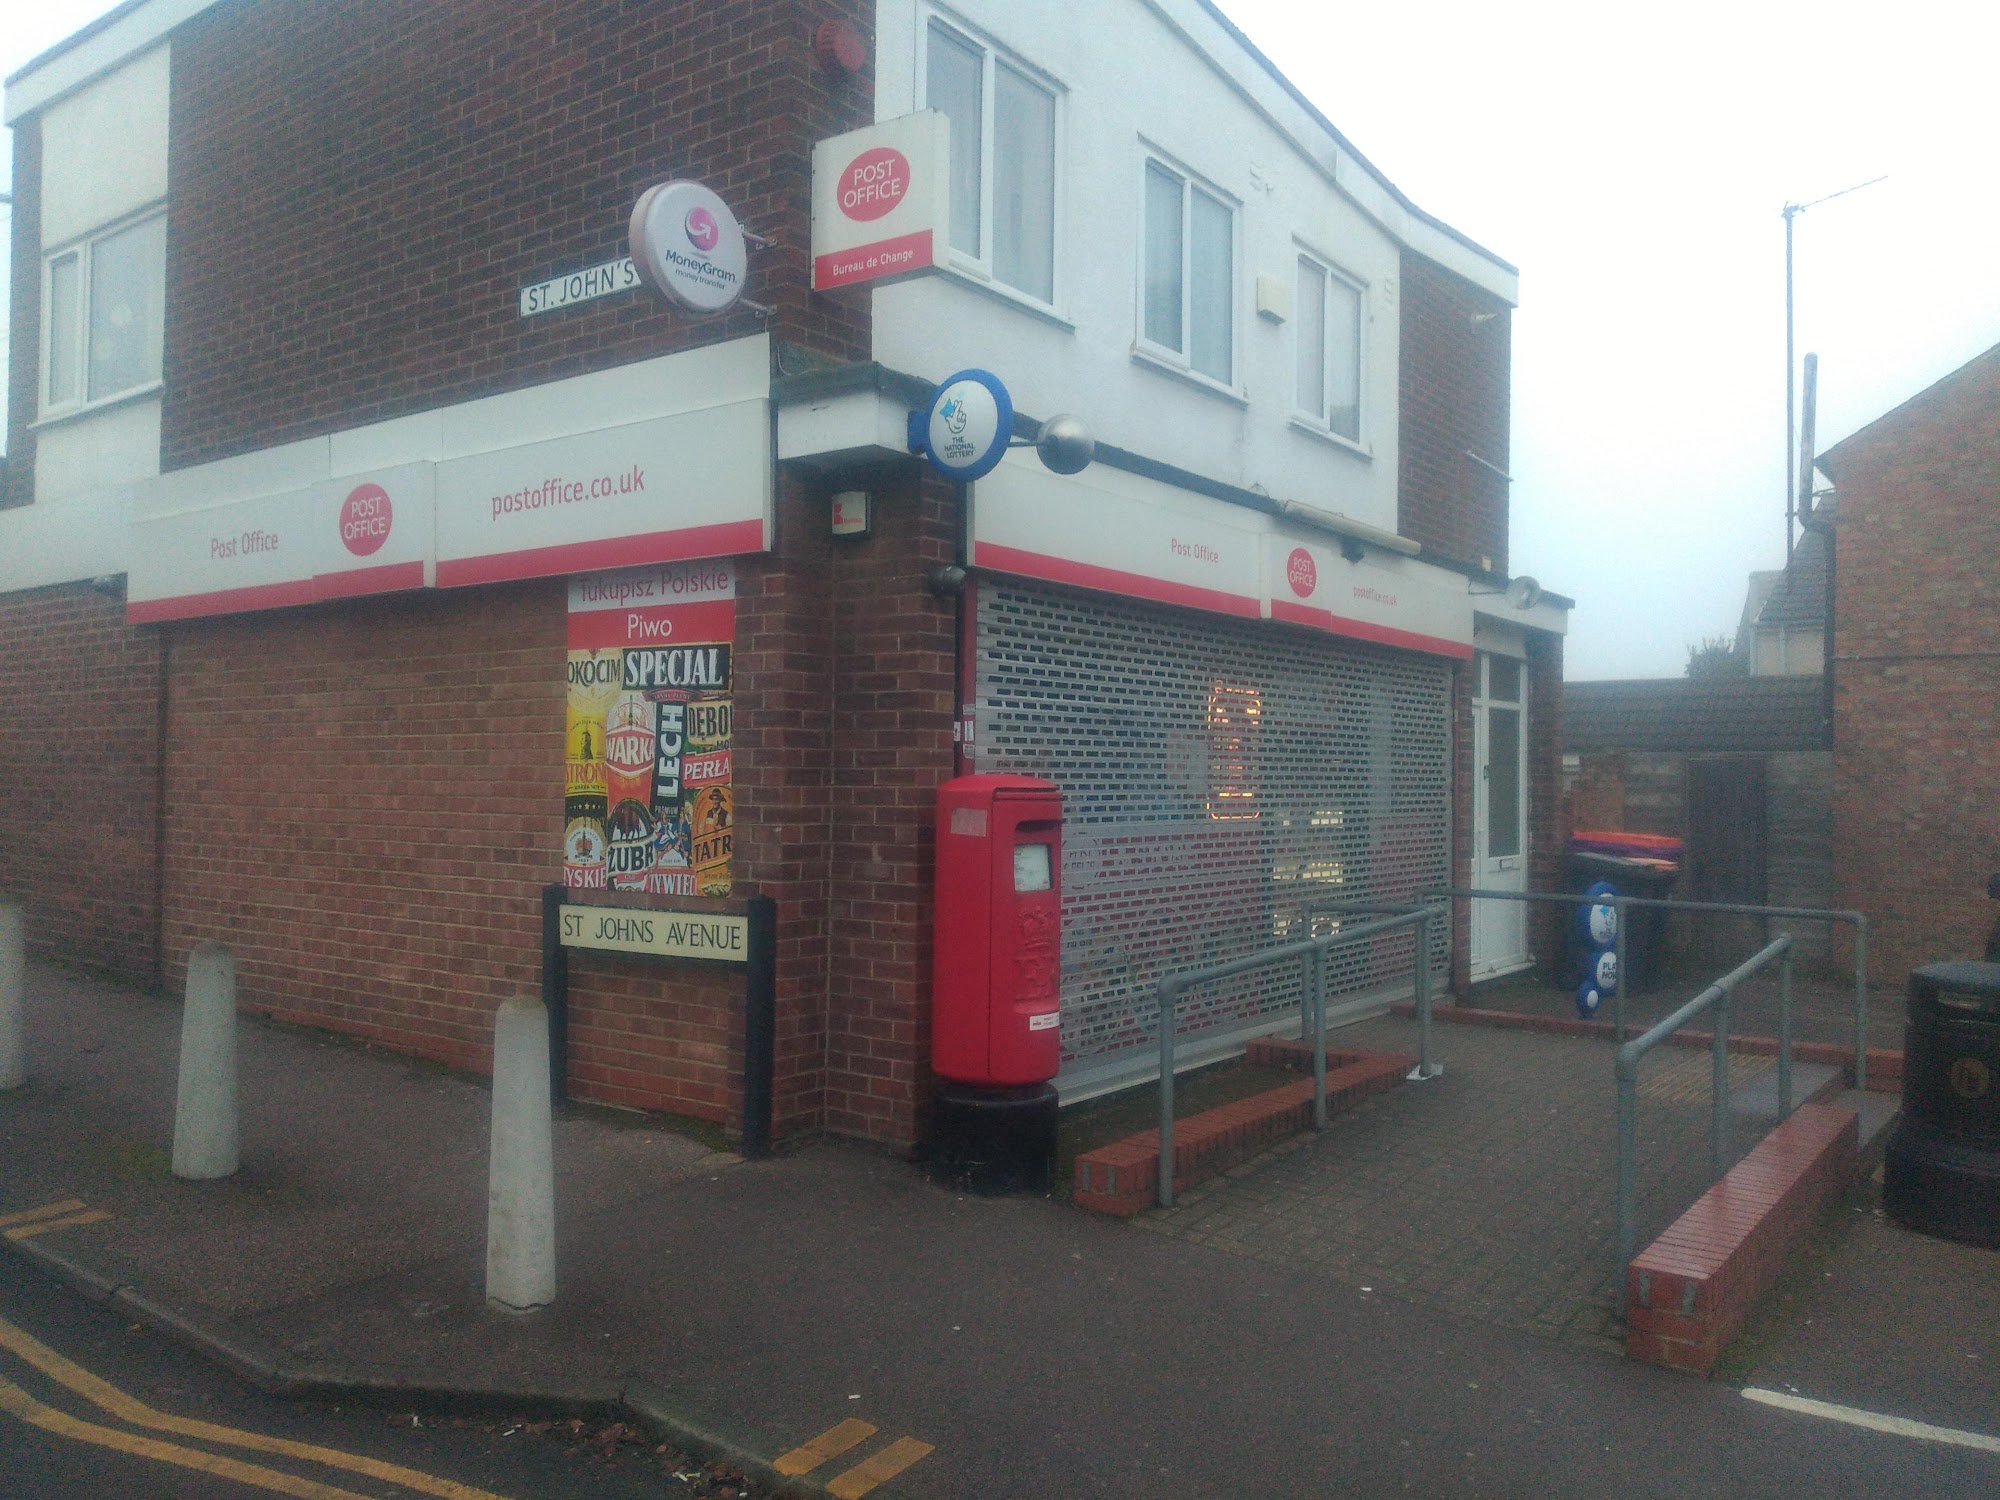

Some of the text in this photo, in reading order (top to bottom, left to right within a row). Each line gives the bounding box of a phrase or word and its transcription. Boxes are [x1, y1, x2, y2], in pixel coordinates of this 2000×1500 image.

[854, 159, 895, 186] POST
[844, 178, 900, 208] OFFICE
[665, 249, 736, 284] MoneyGram
[833, 249, 914, 276] Bureau de Change
[529, 259, 634, 312] ST. JOHN'S
[675, 268, 726, 290] money transfer
[944, 443, 975, 452] NATIONAL
[952, 436, 964, 444] THE
[946, 450, 975, 459] LOTTERY
[492, 464, 645, 521] postoffice.co.uk
[351, 496, 381, 518] POST
[344, 517, 386, 540] OFFICE
[211, 530, 279, 559] Post Office
[1171, 538, 1219, 563] Post Office
[1293, 557, 1311, 573] POST
[661, 567, 729, 595] Polskie
[1289, 570, 1313, 587] OFFICE
[1353, 586, 1398, 606] postoffice.co.uk
[627, 613, 673, 639] Piwo
[567, 658, 621, 687] OKOCIM
[607, 735, 655, 766] WARKA
[657, 703, 685, 798] LECH
[684, 756, 730, 782] PERŁA
[564, 914, 741, 950] ST JOHNS AVENUE
[1602, 962, 1617, 971] PLA
